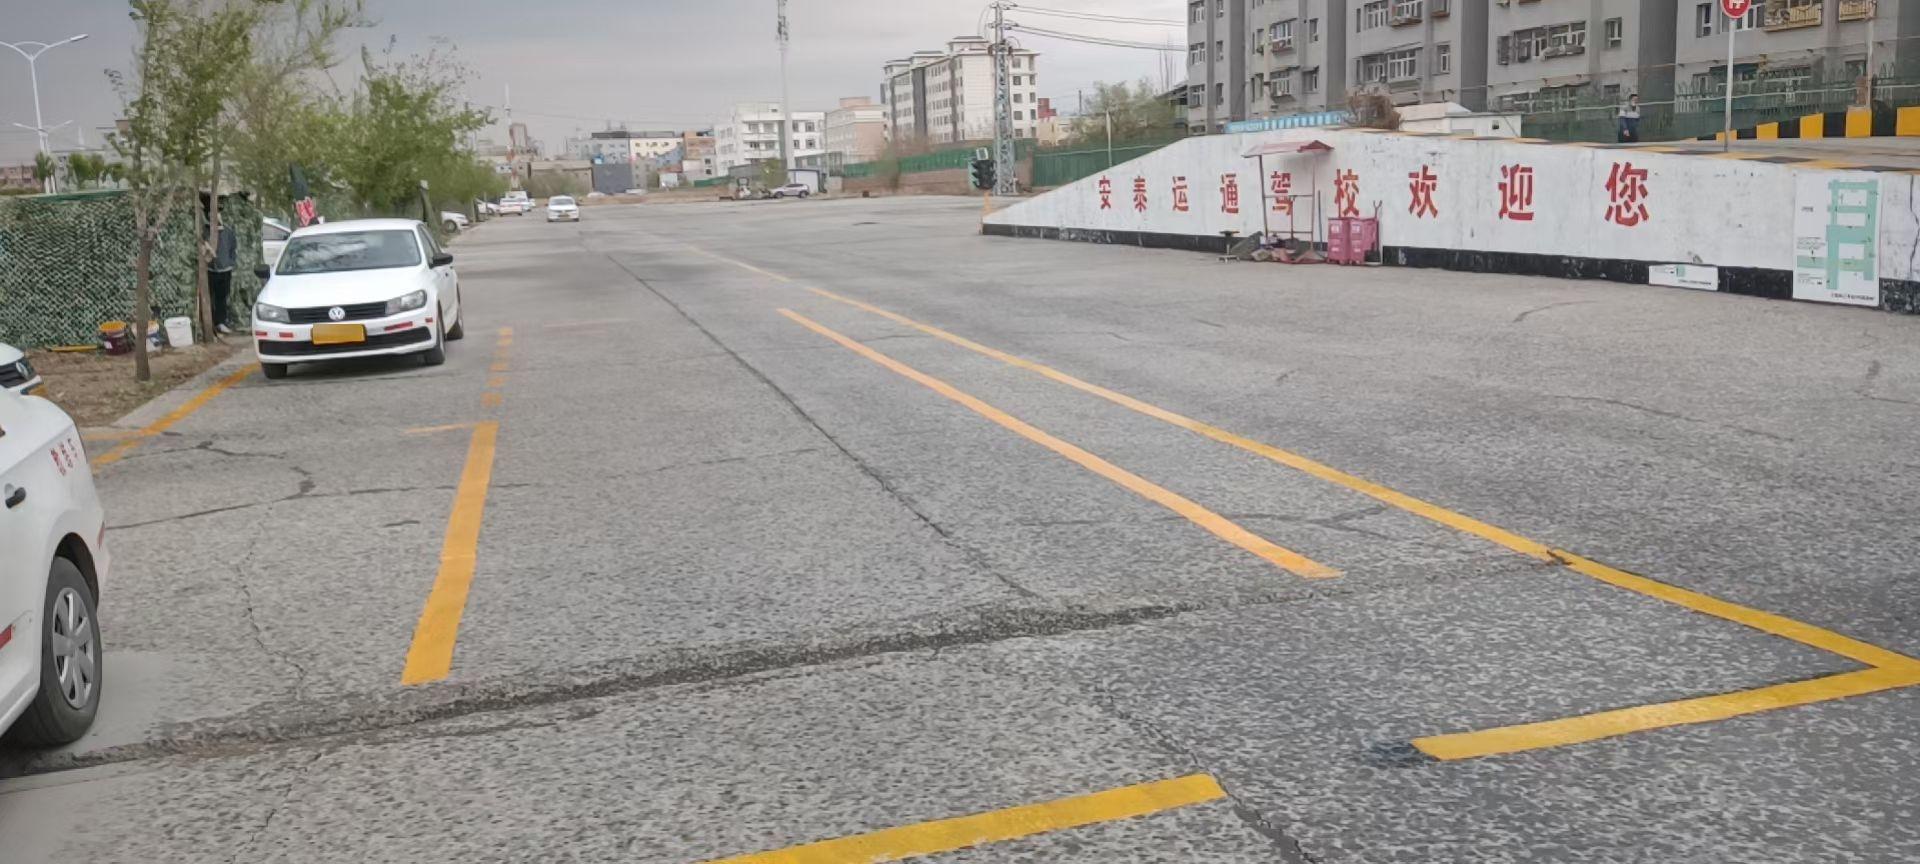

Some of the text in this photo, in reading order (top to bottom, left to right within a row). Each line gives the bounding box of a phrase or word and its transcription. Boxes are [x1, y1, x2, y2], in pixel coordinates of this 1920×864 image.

[1098, 162, 1649, 227] 安泰运通驾校欢迎您
